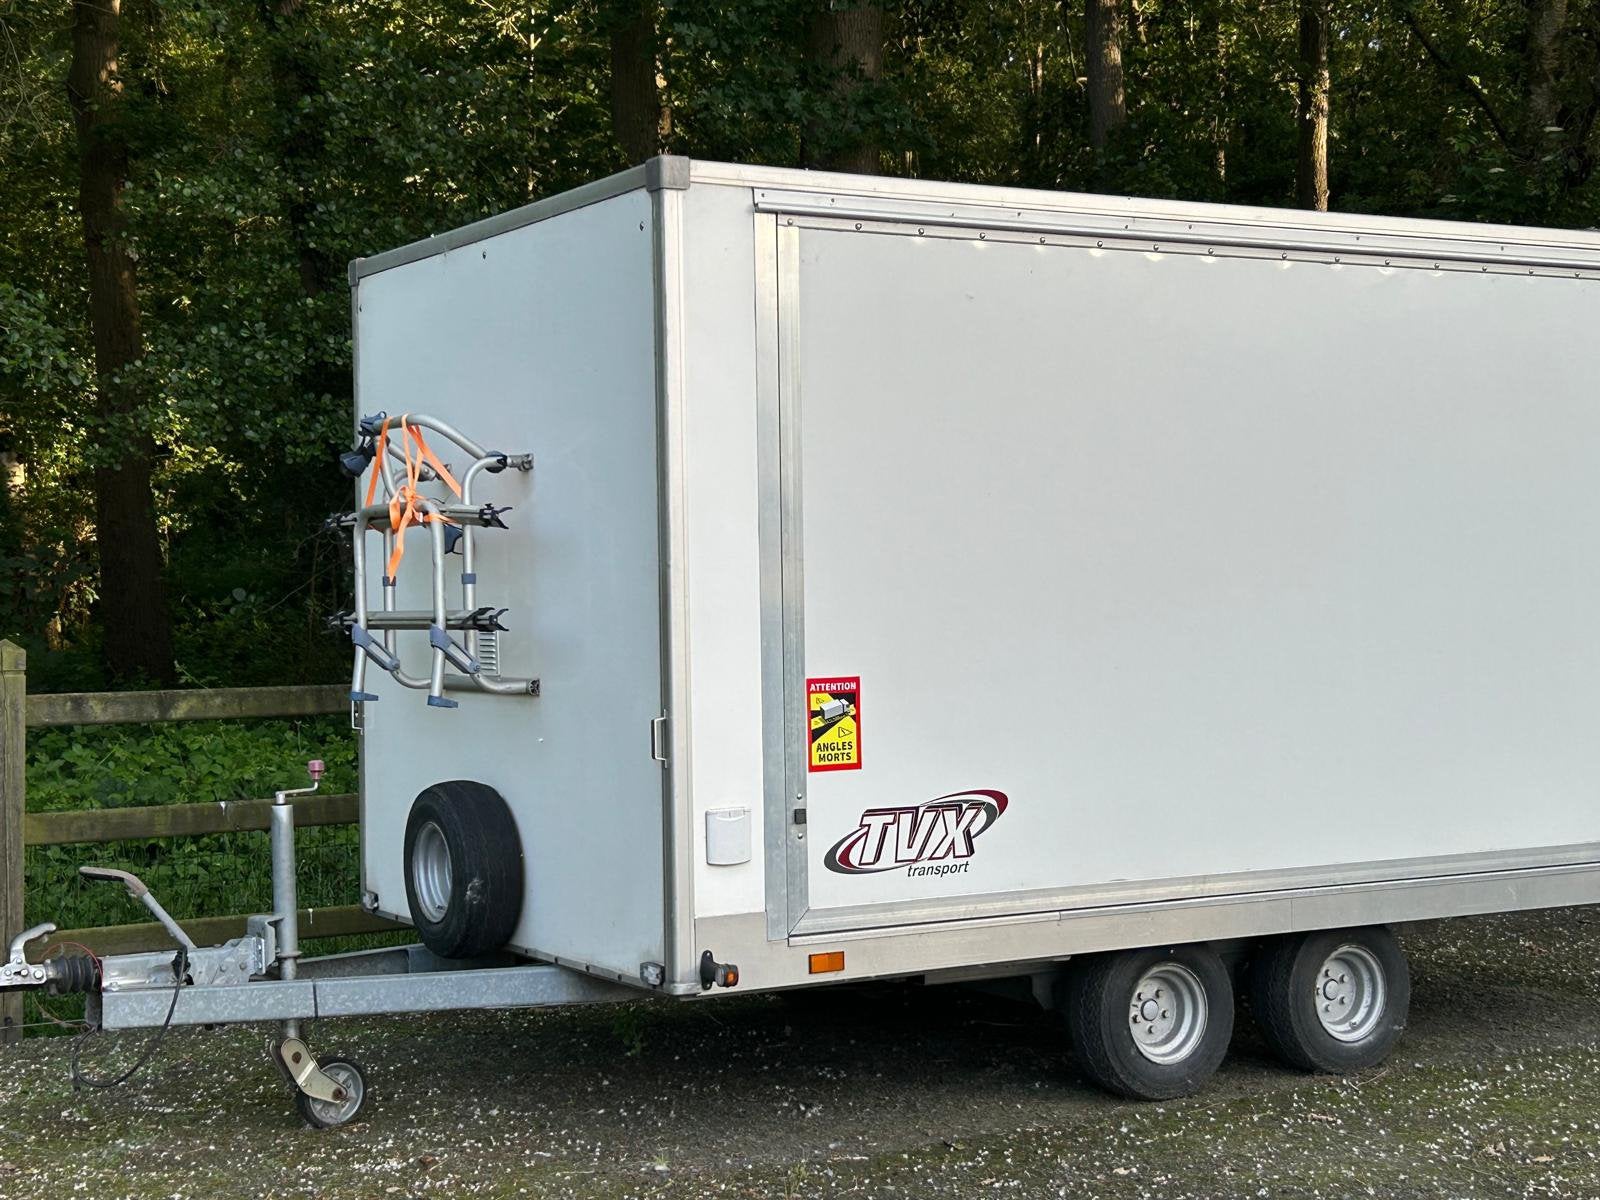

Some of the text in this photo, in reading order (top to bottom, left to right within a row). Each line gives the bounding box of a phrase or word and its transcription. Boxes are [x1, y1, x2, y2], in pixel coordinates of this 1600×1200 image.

[809, 681, 857, 692] ATTENTION
[816, 741, 853, 753] ANGLES
[818, 752, 852, 763] MORTS
[858, 802, 987, 866] TVX
[907, 861, 970, 878] transport
